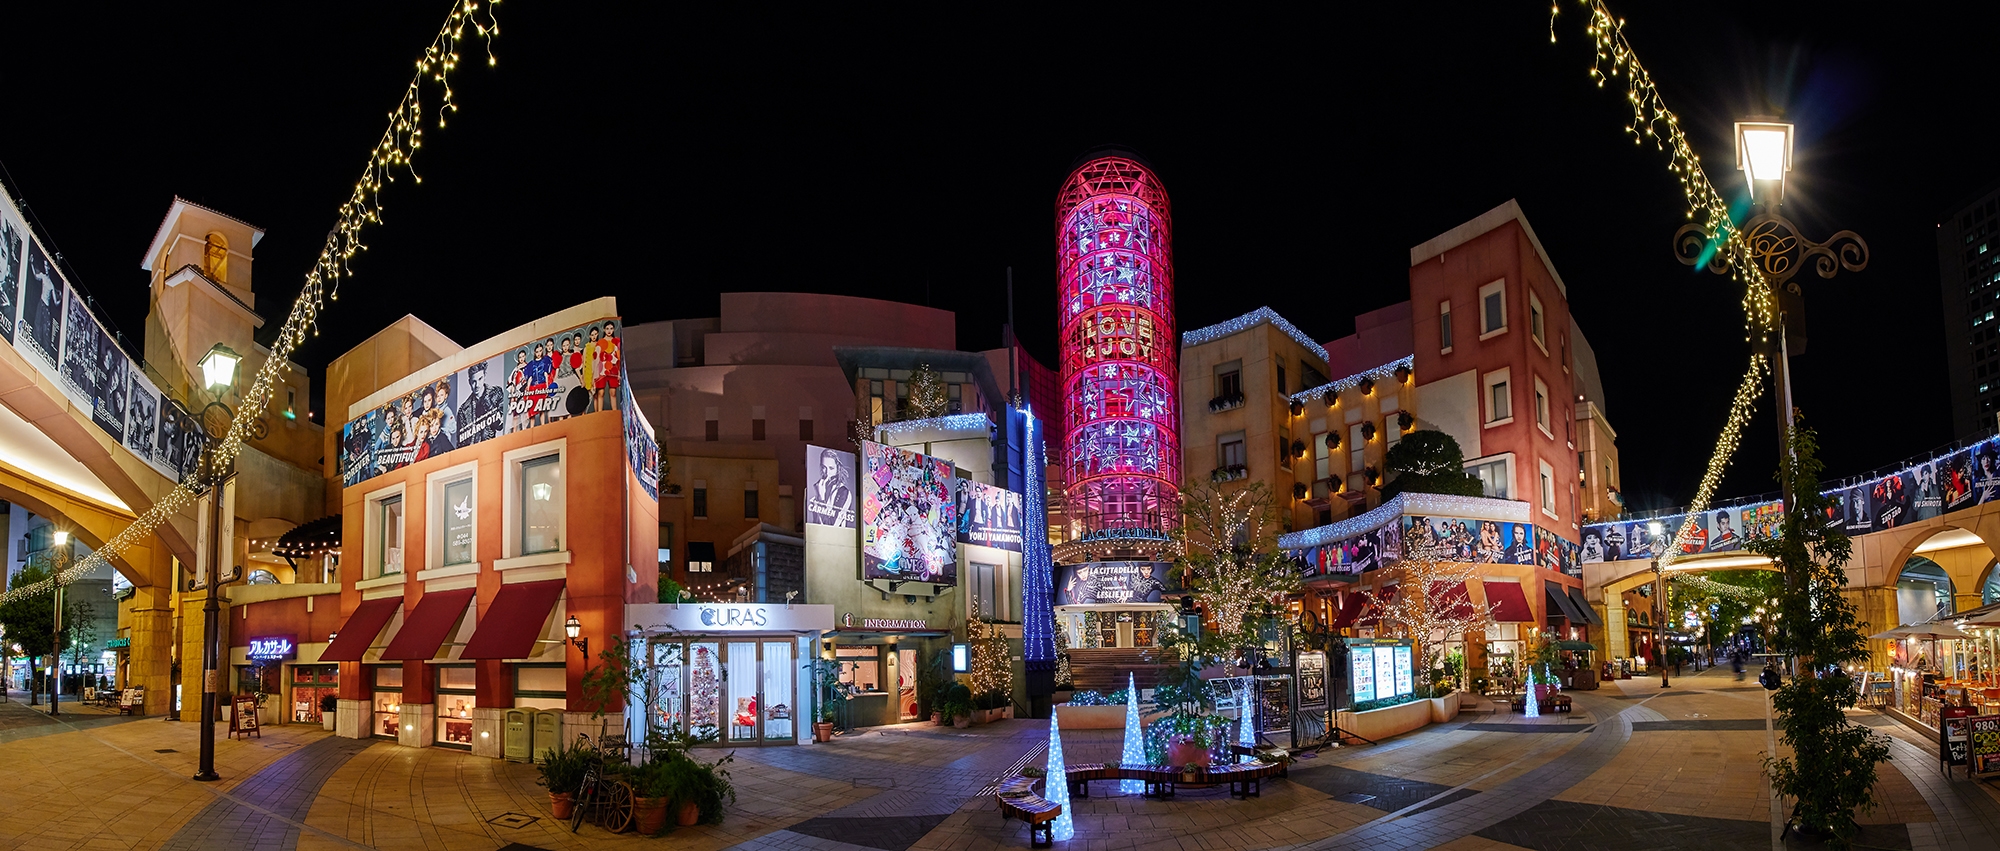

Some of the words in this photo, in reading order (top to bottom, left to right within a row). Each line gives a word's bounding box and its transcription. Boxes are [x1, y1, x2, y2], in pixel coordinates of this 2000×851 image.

[1086, 316, 1151, 338] LOVE
[1085, 345, 1096, 358] &
[1101, 338, 1151, 358] JOY
[509, 400, 533, 415] POP
[534, 397, 560, 411] ART
[459, 420, 486, 442] HIKARU
[486, 412, 501, 426] OTA
[378, 453, 415, 465] BEAUTIFUL
[344, 454, 371, 484] FOREVER
[808, 503, 837, 518] CARMEN
[970, 531, 988, 541] YOHJI
[988, 533, 1021, 543] YAMAMOTO
[1100, 566, 1139, 574] CITTADELLA
[1097, 590, 1120, 599] LESLIE
[1120, 590, 1134, 598] KEE
[700, 607, 768, 627] CURAS
[864, 617, 928, 630] INFORMATION
[248, 639, 292, 656] アルカサール
[1975, 720, 1994, 731] 980
